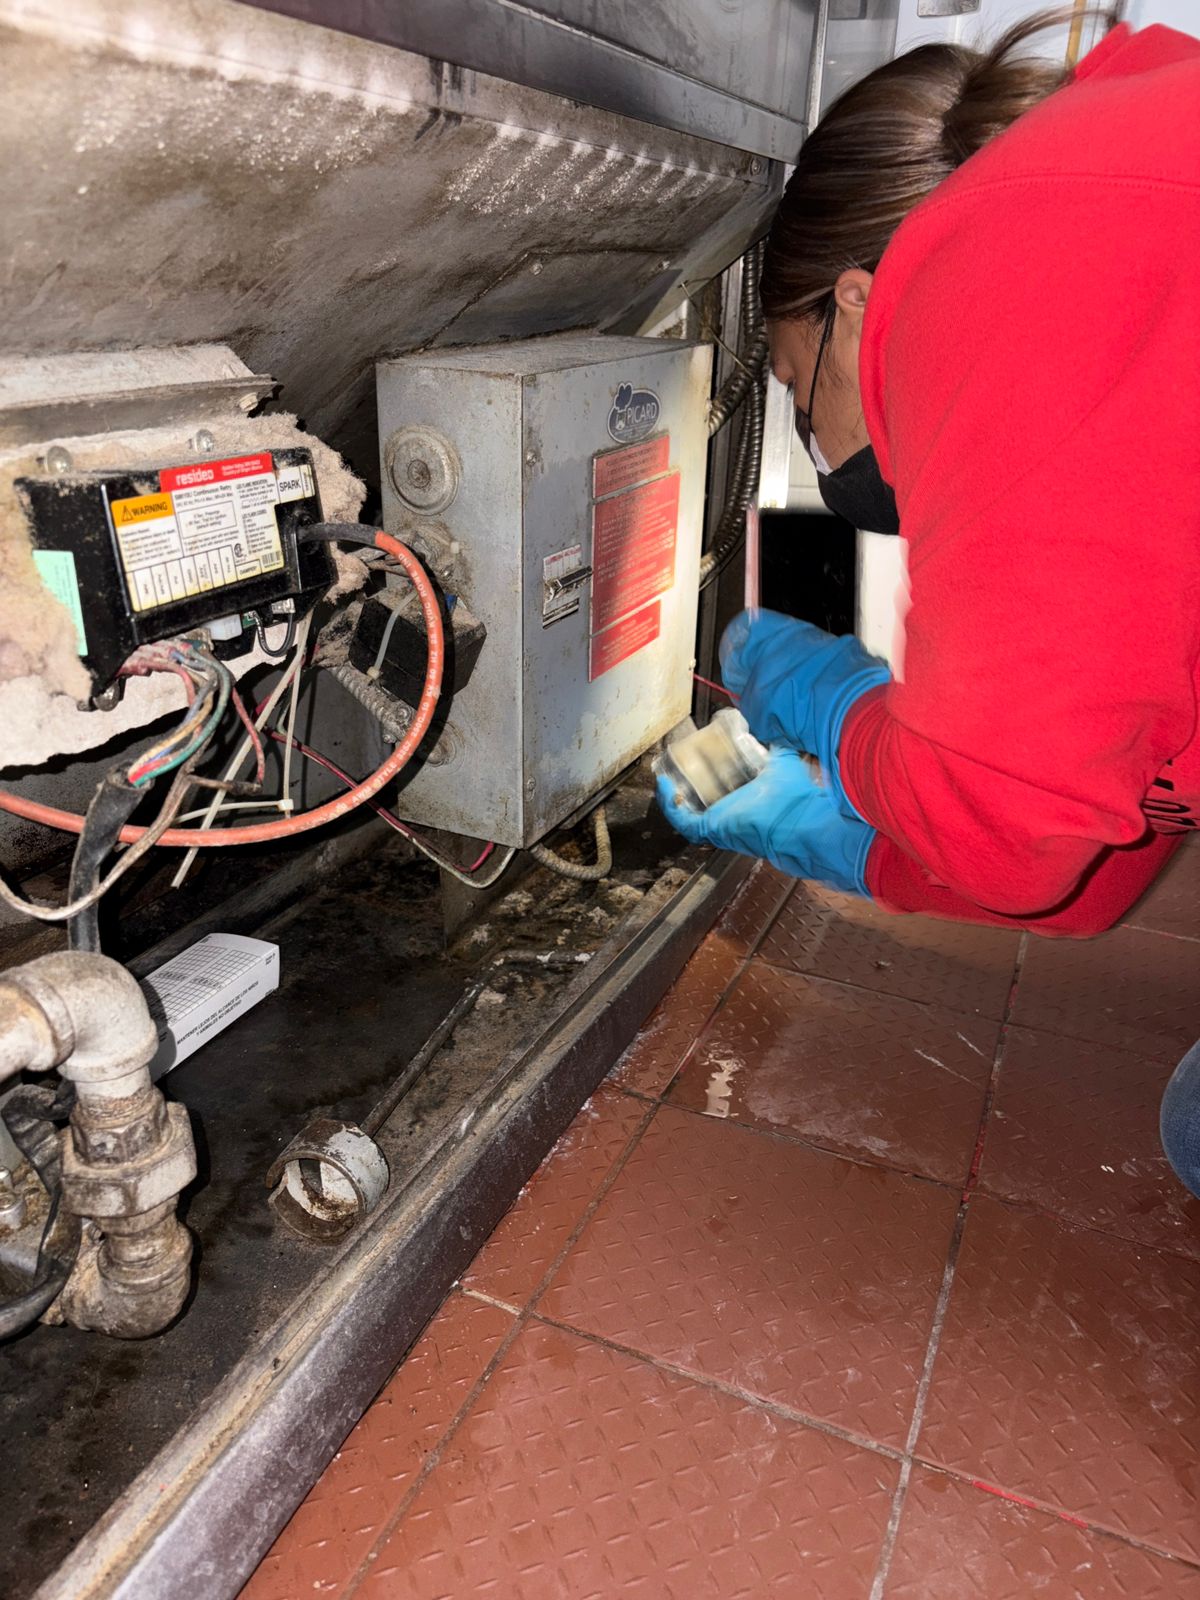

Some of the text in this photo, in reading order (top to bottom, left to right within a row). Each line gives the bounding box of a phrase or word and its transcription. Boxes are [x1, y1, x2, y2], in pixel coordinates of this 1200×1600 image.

[627, 402, 657, 425] PICARD
[175, 468, 214, 486] resideo
[279, 479, 301, 492] SPARK
[131, 501, 168, 516] WARNING
[396, 551, 412, 568] IND
[409, 569, 427, 597] ROWE
[430, 649, 437, 662] HZ
[424, 684, 434, 697] KV
